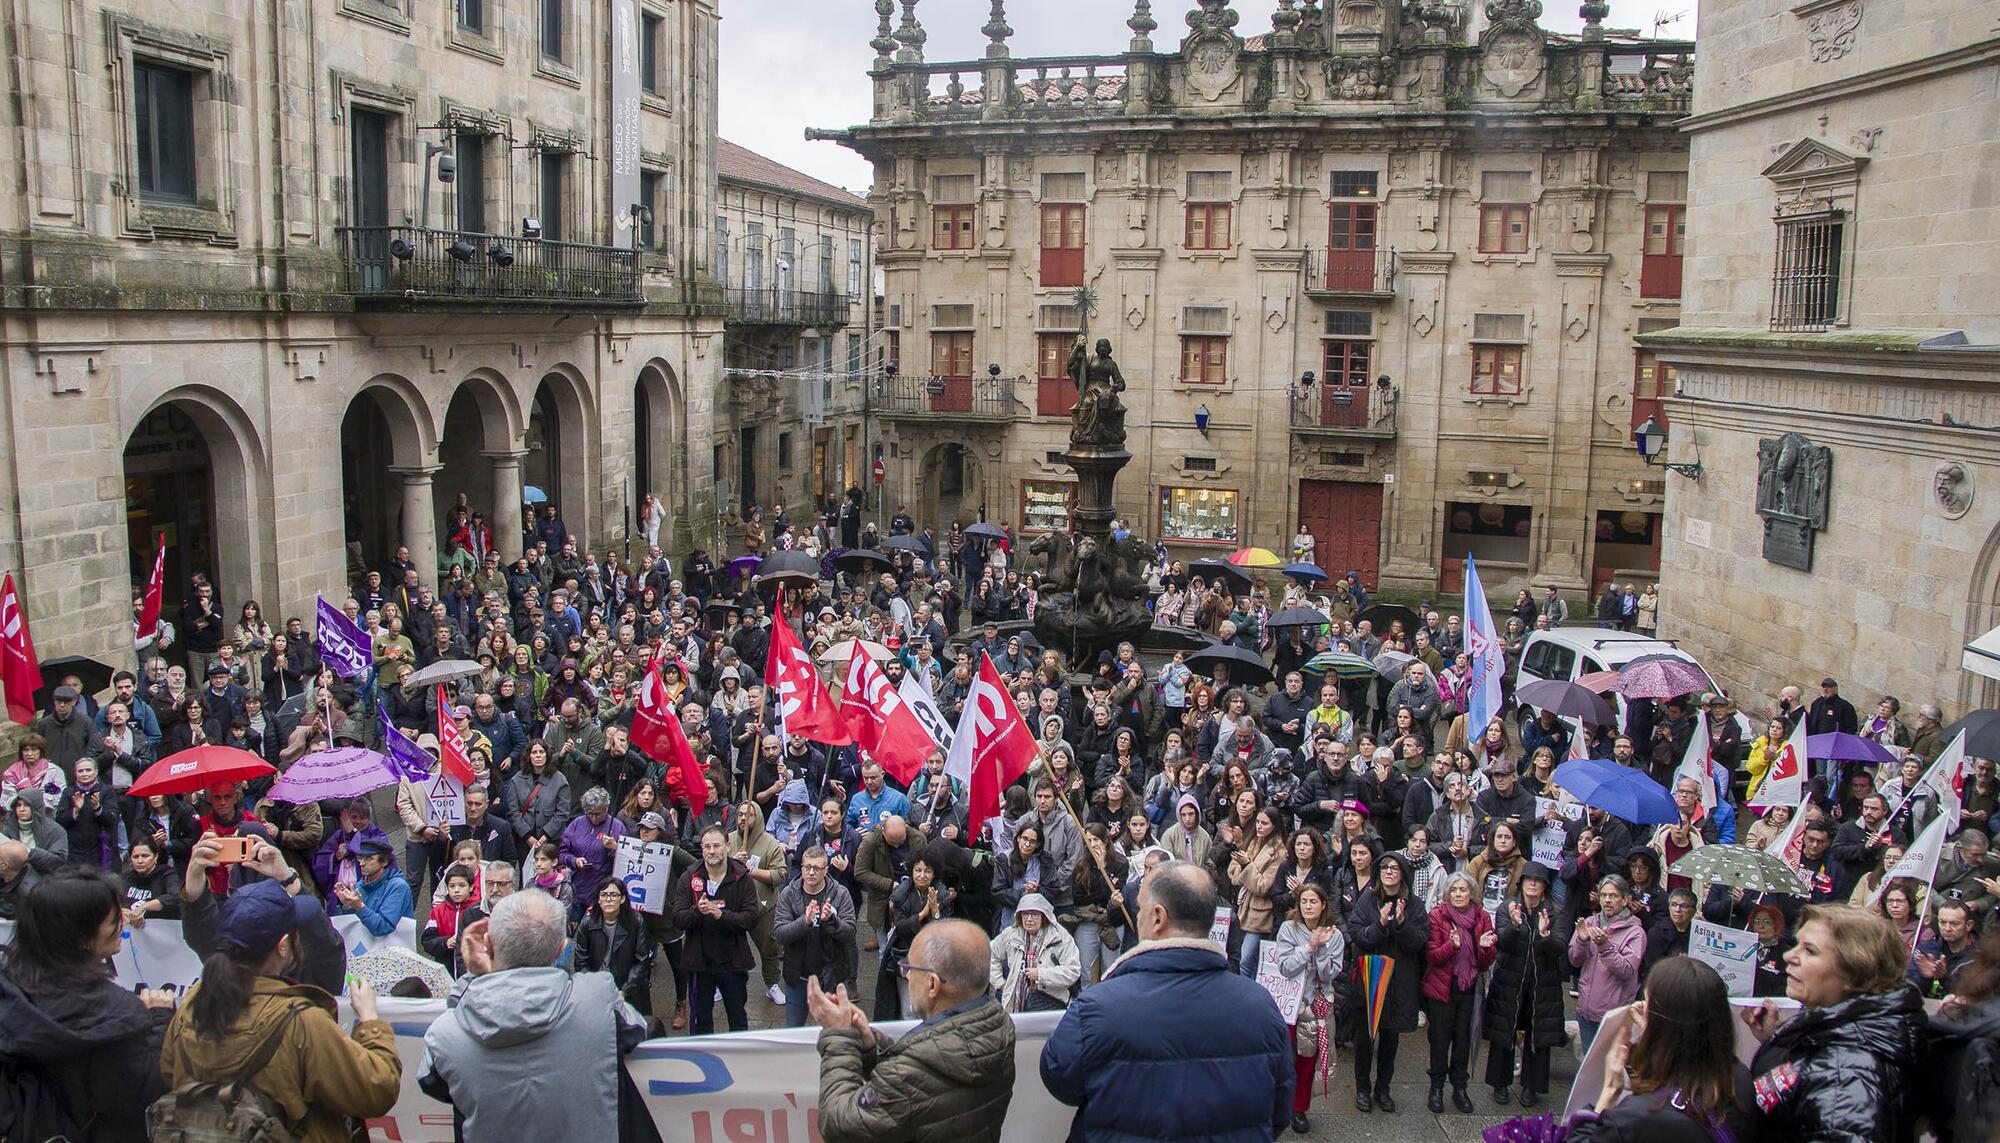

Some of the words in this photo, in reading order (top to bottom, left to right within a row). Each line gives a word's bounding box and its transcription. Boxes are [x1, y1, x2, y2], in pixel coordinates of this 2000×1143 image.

[631, 97, 639, 161] SANTIAGO
[615, 123, 623, 174] MUSEO
[1694, 924, 1715, 939] Asina
[1717, 932, 1723, 940] a
[1706, 937, 1737, 950] ILP
